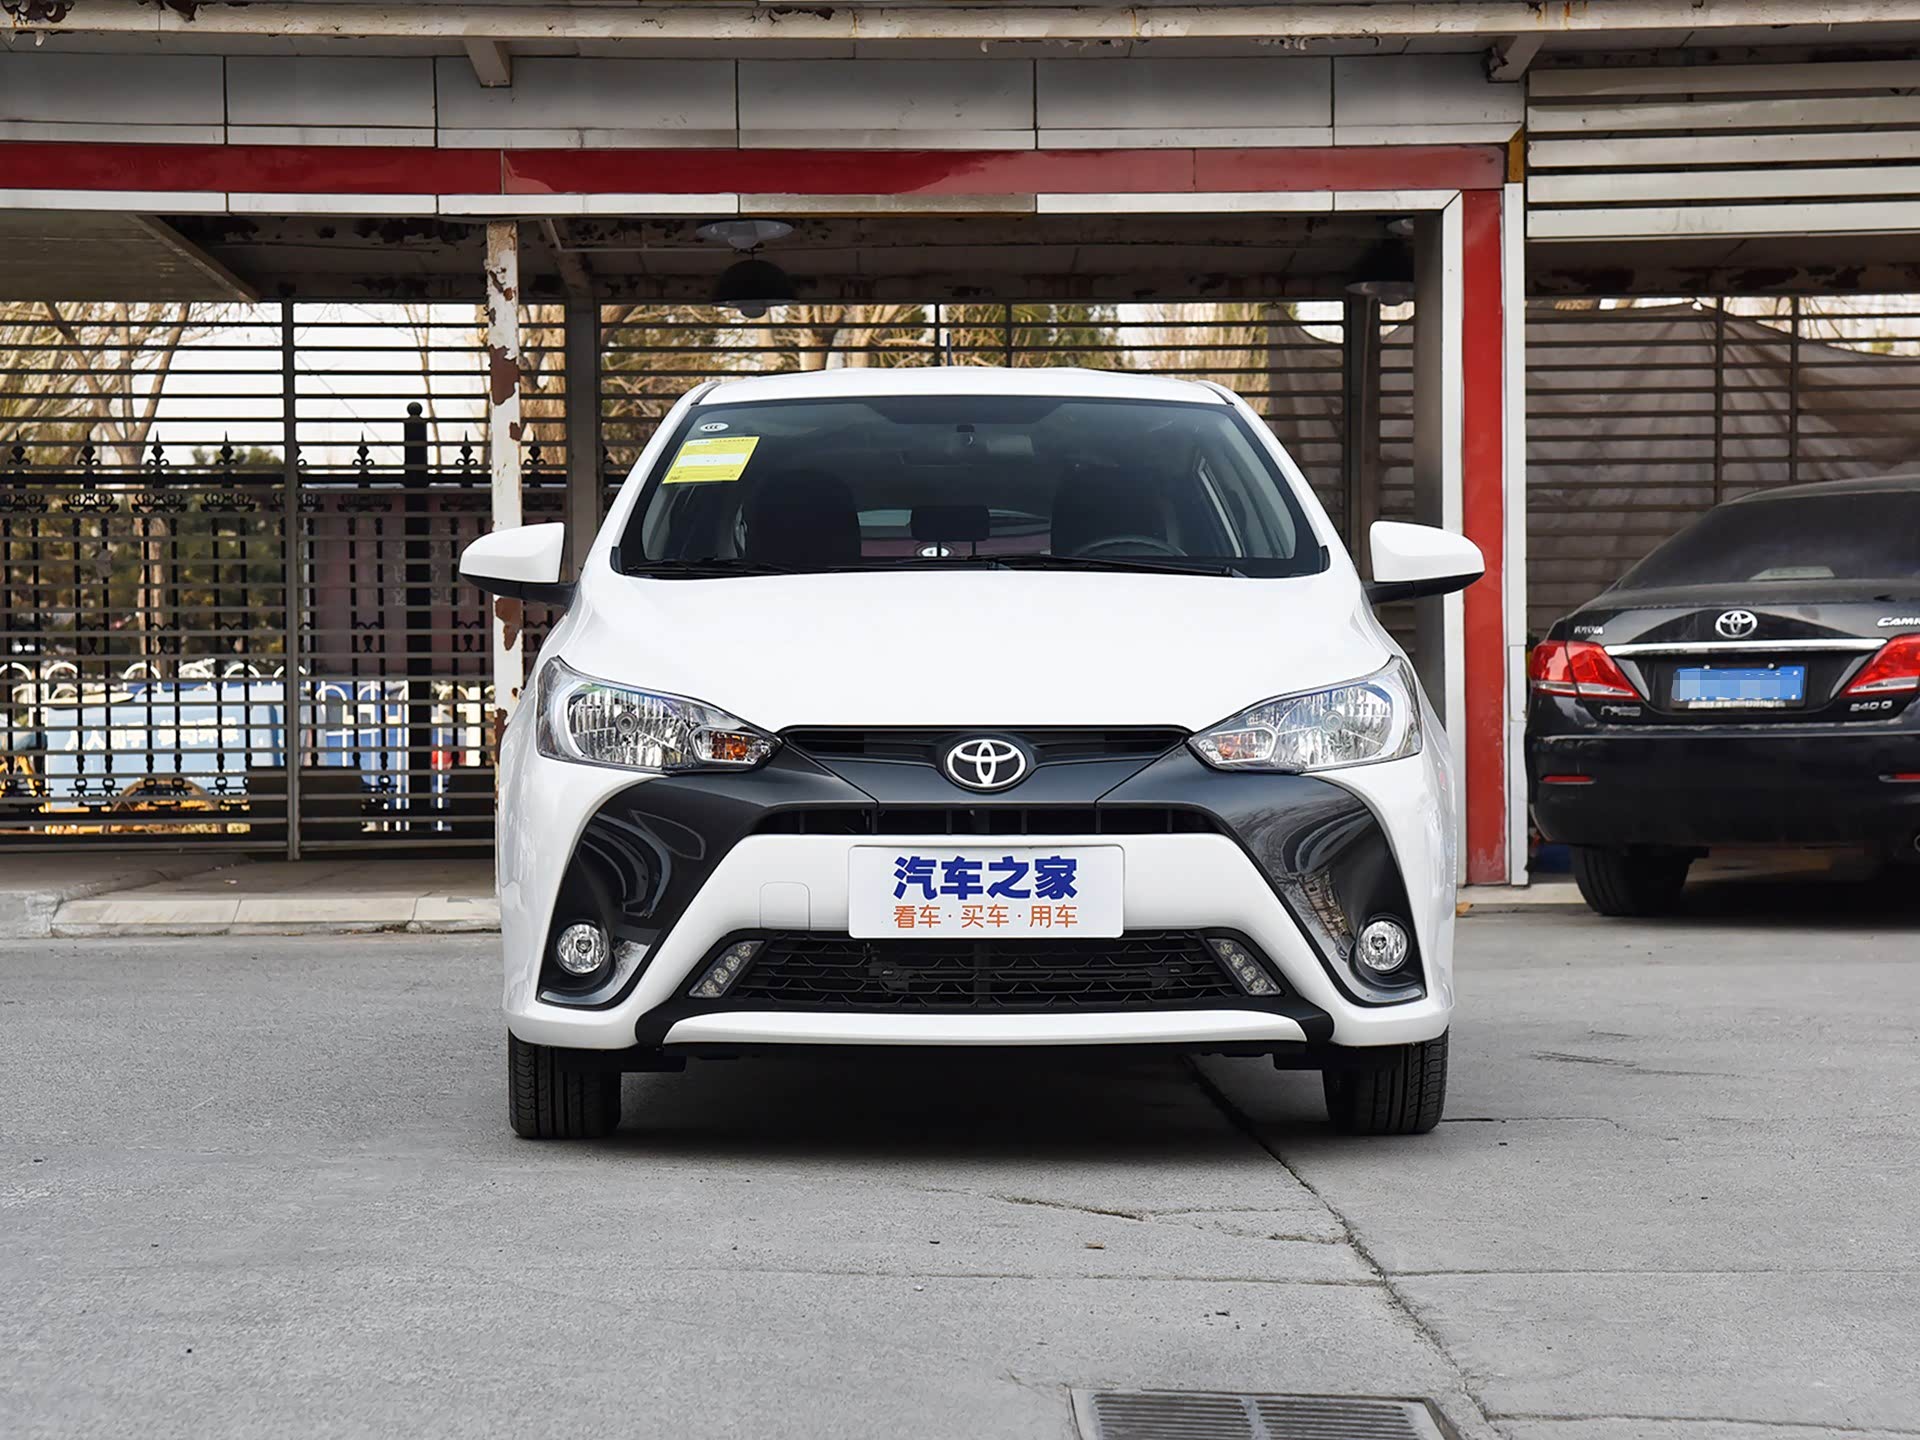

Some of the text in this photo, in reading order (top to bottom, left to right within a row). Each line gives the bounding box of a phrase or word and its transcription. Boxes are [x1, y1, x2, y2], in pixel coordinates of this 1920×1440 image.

[893, 855, 1078, 900] 汽车之家
[893, 904, 1078, 929] 看车·买车·用车
